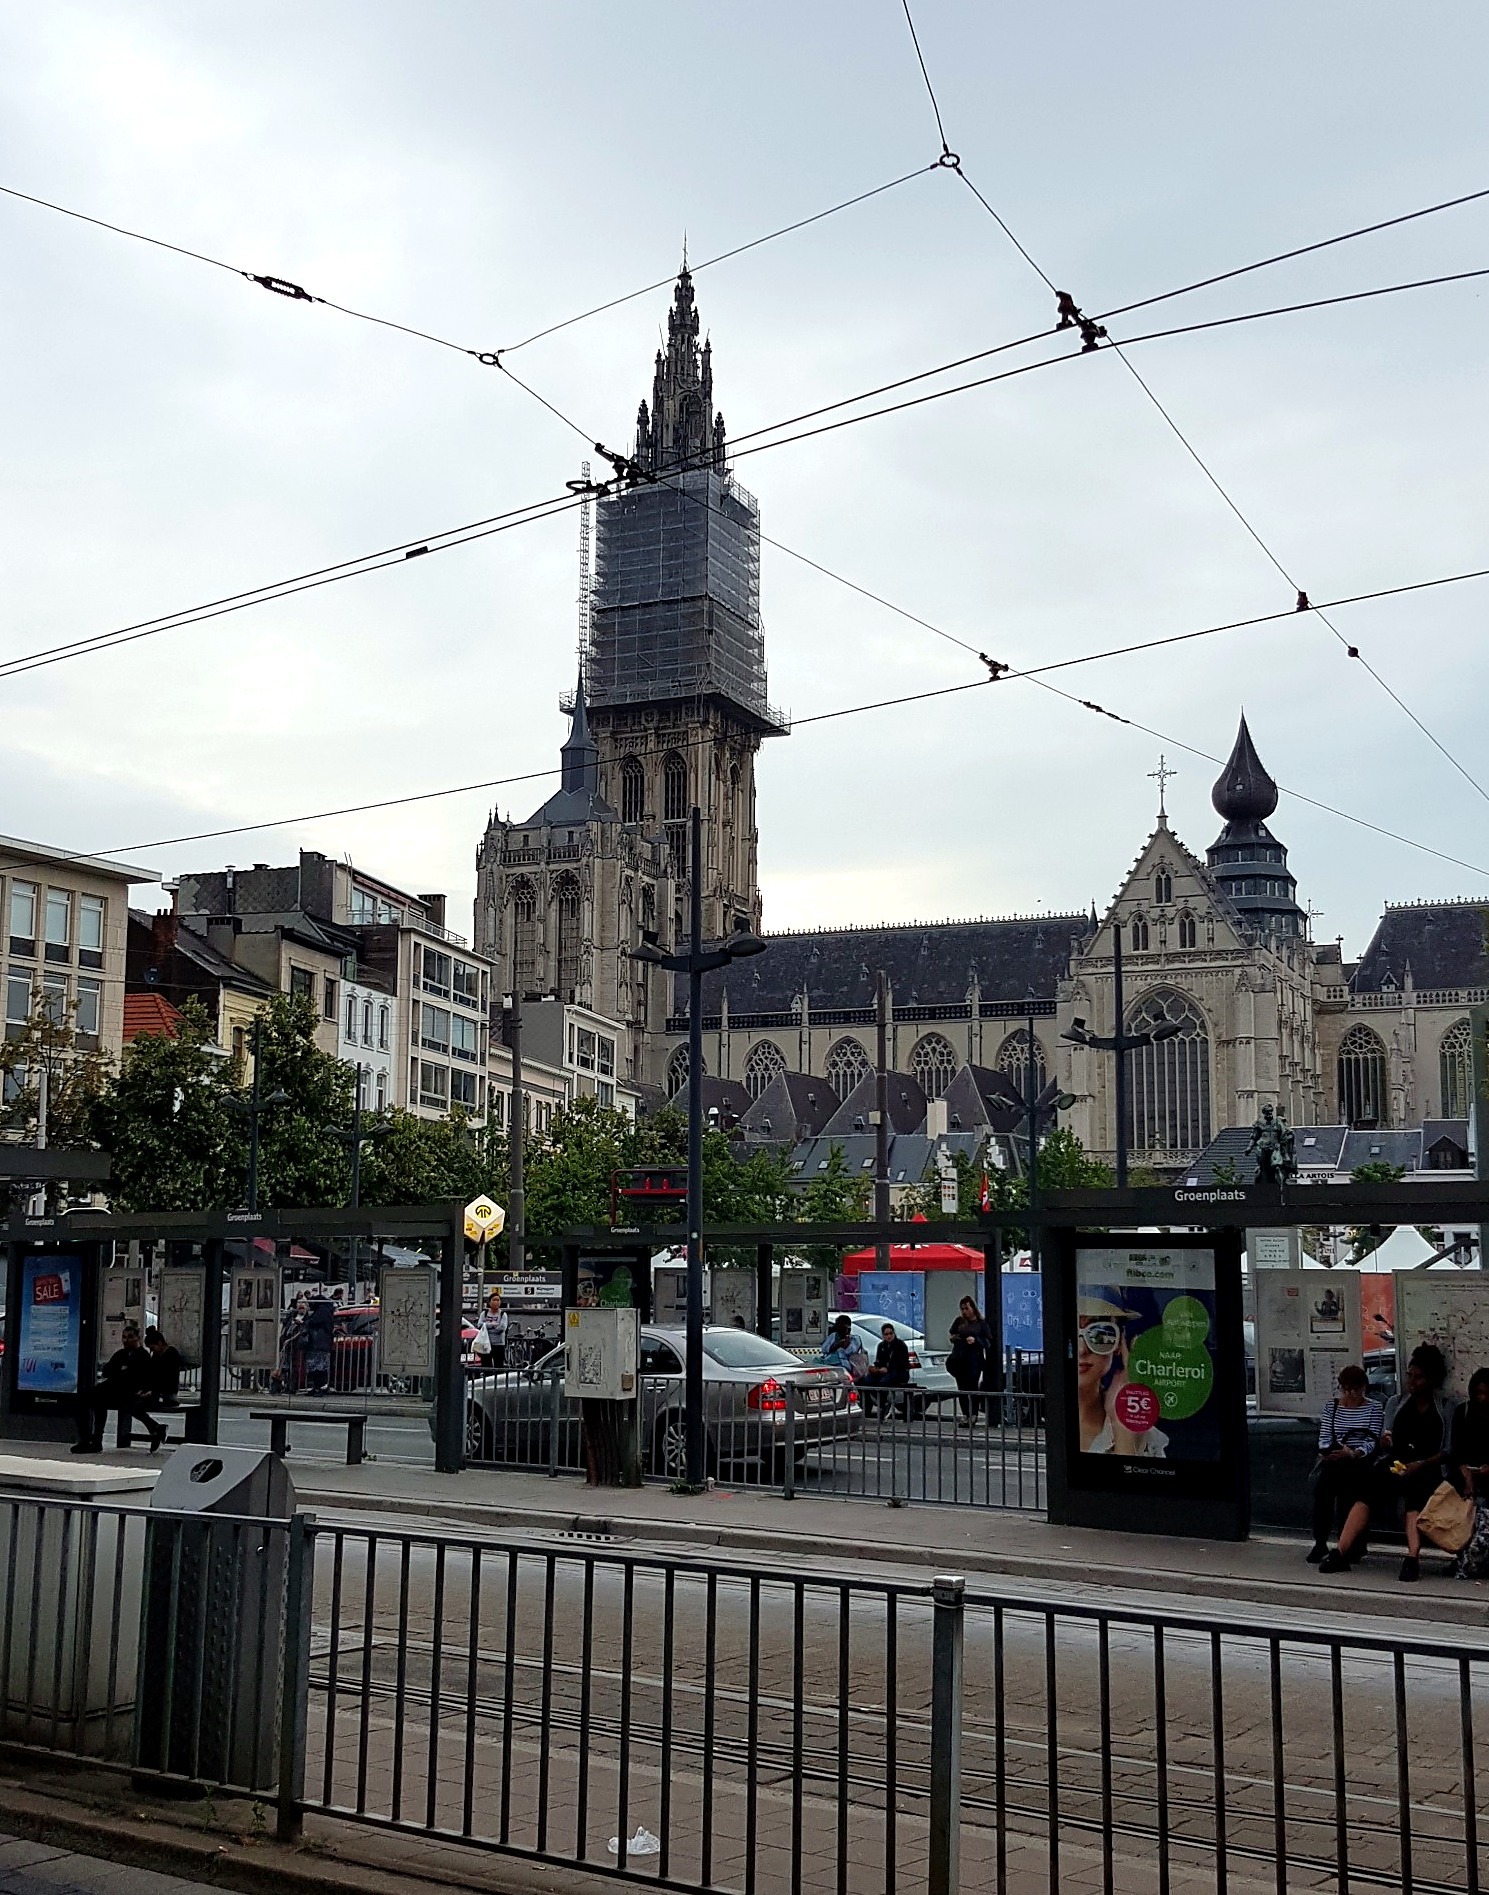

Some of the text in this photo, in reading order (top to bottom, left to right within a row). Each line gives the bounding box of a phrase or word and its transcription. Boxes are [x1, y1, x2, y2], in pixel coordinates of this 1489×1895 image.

[1174, 1188, 1246, 1203] Groenplaats
[25, 1217, 55, 1227] Groenplaats
[227, 1212, 263, 1223] Groenplaats
[610, 1226, 640, 1235] Groenplaats
[503, 1274, 547, 1286] Groenplaats
[35, 1284, 60, 1301] SALE
[1135, 1359, 1205, 1379] Charleroi
[1154, 1379, 1186, 1388] AIRPORT
[1127, 1396, 1151, 1413] 5€
[1132, 1465, 1176, 1476] Clear Channel
